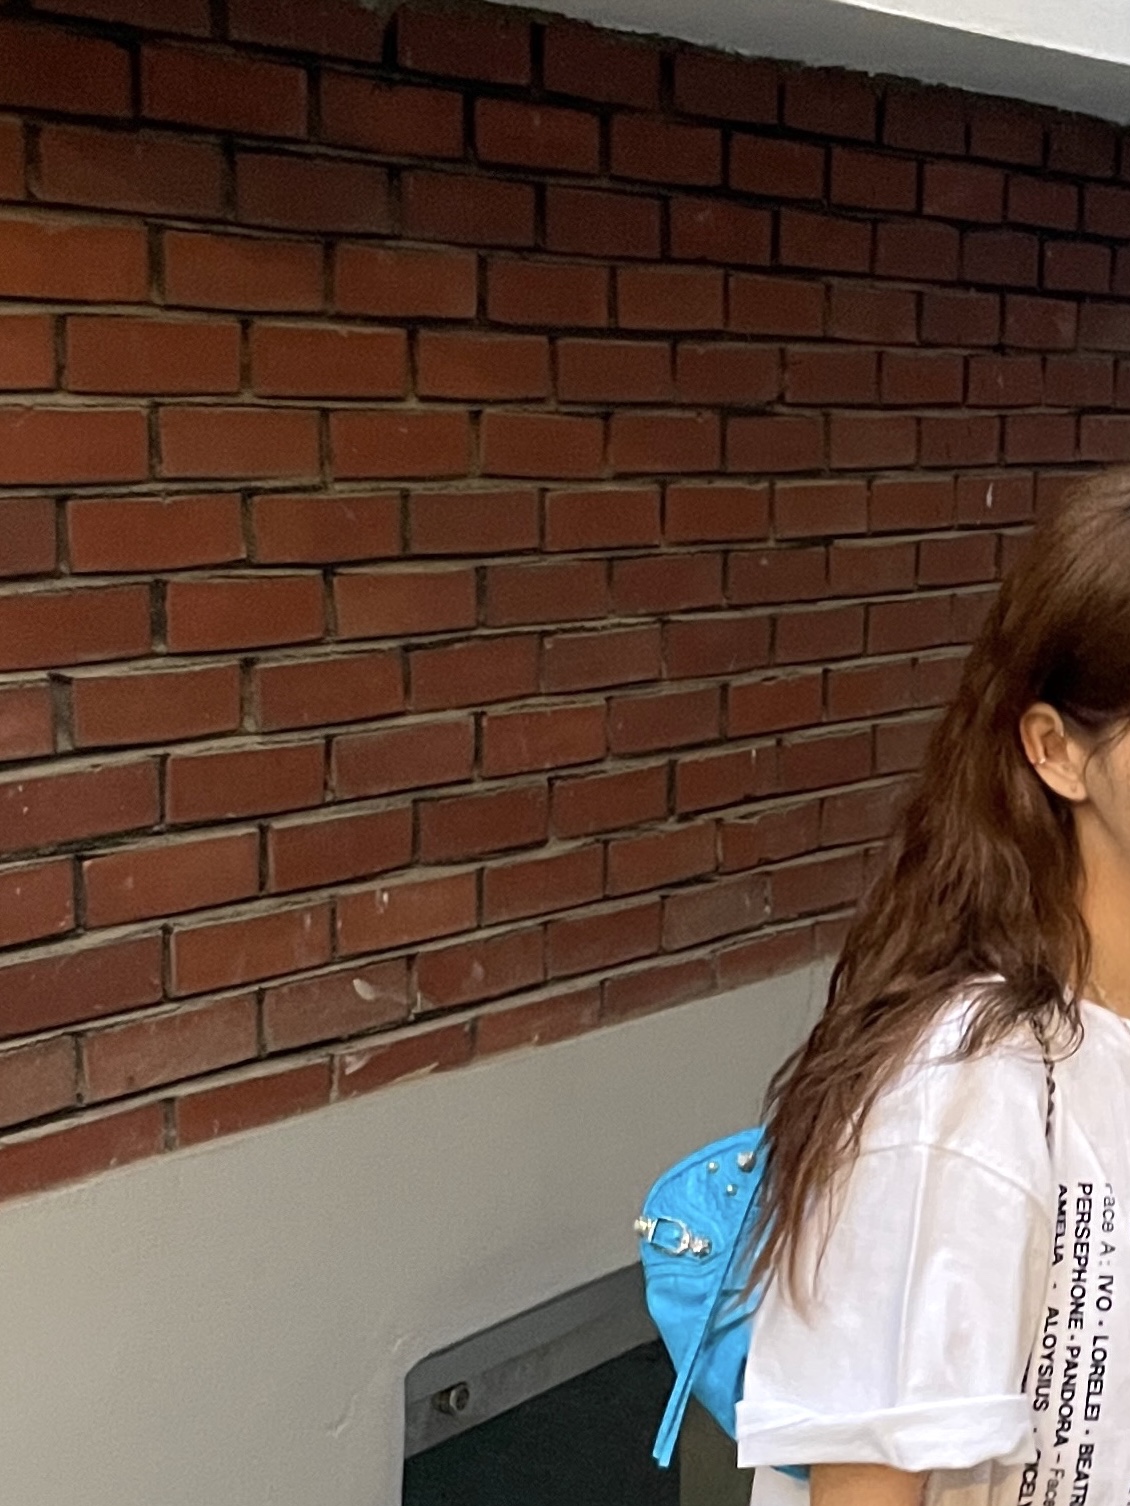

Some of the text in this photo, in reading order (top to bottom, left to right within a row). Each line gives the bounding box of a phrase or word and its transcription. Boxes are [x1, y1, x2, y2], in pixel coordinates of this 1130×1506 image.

[1052, 1184, 1068, 1266] AMELIA
[1067, 1182, 1093, 1330] PERSEPHONE
[1096, 1275, 1114, 1312] IVO
[1033, 1306, 1060, 1412] ALOYSIUS
[1053, 1345, 1081, 1447] PANDORA
[1084, 1335, 1112, 1421] LORELEI
